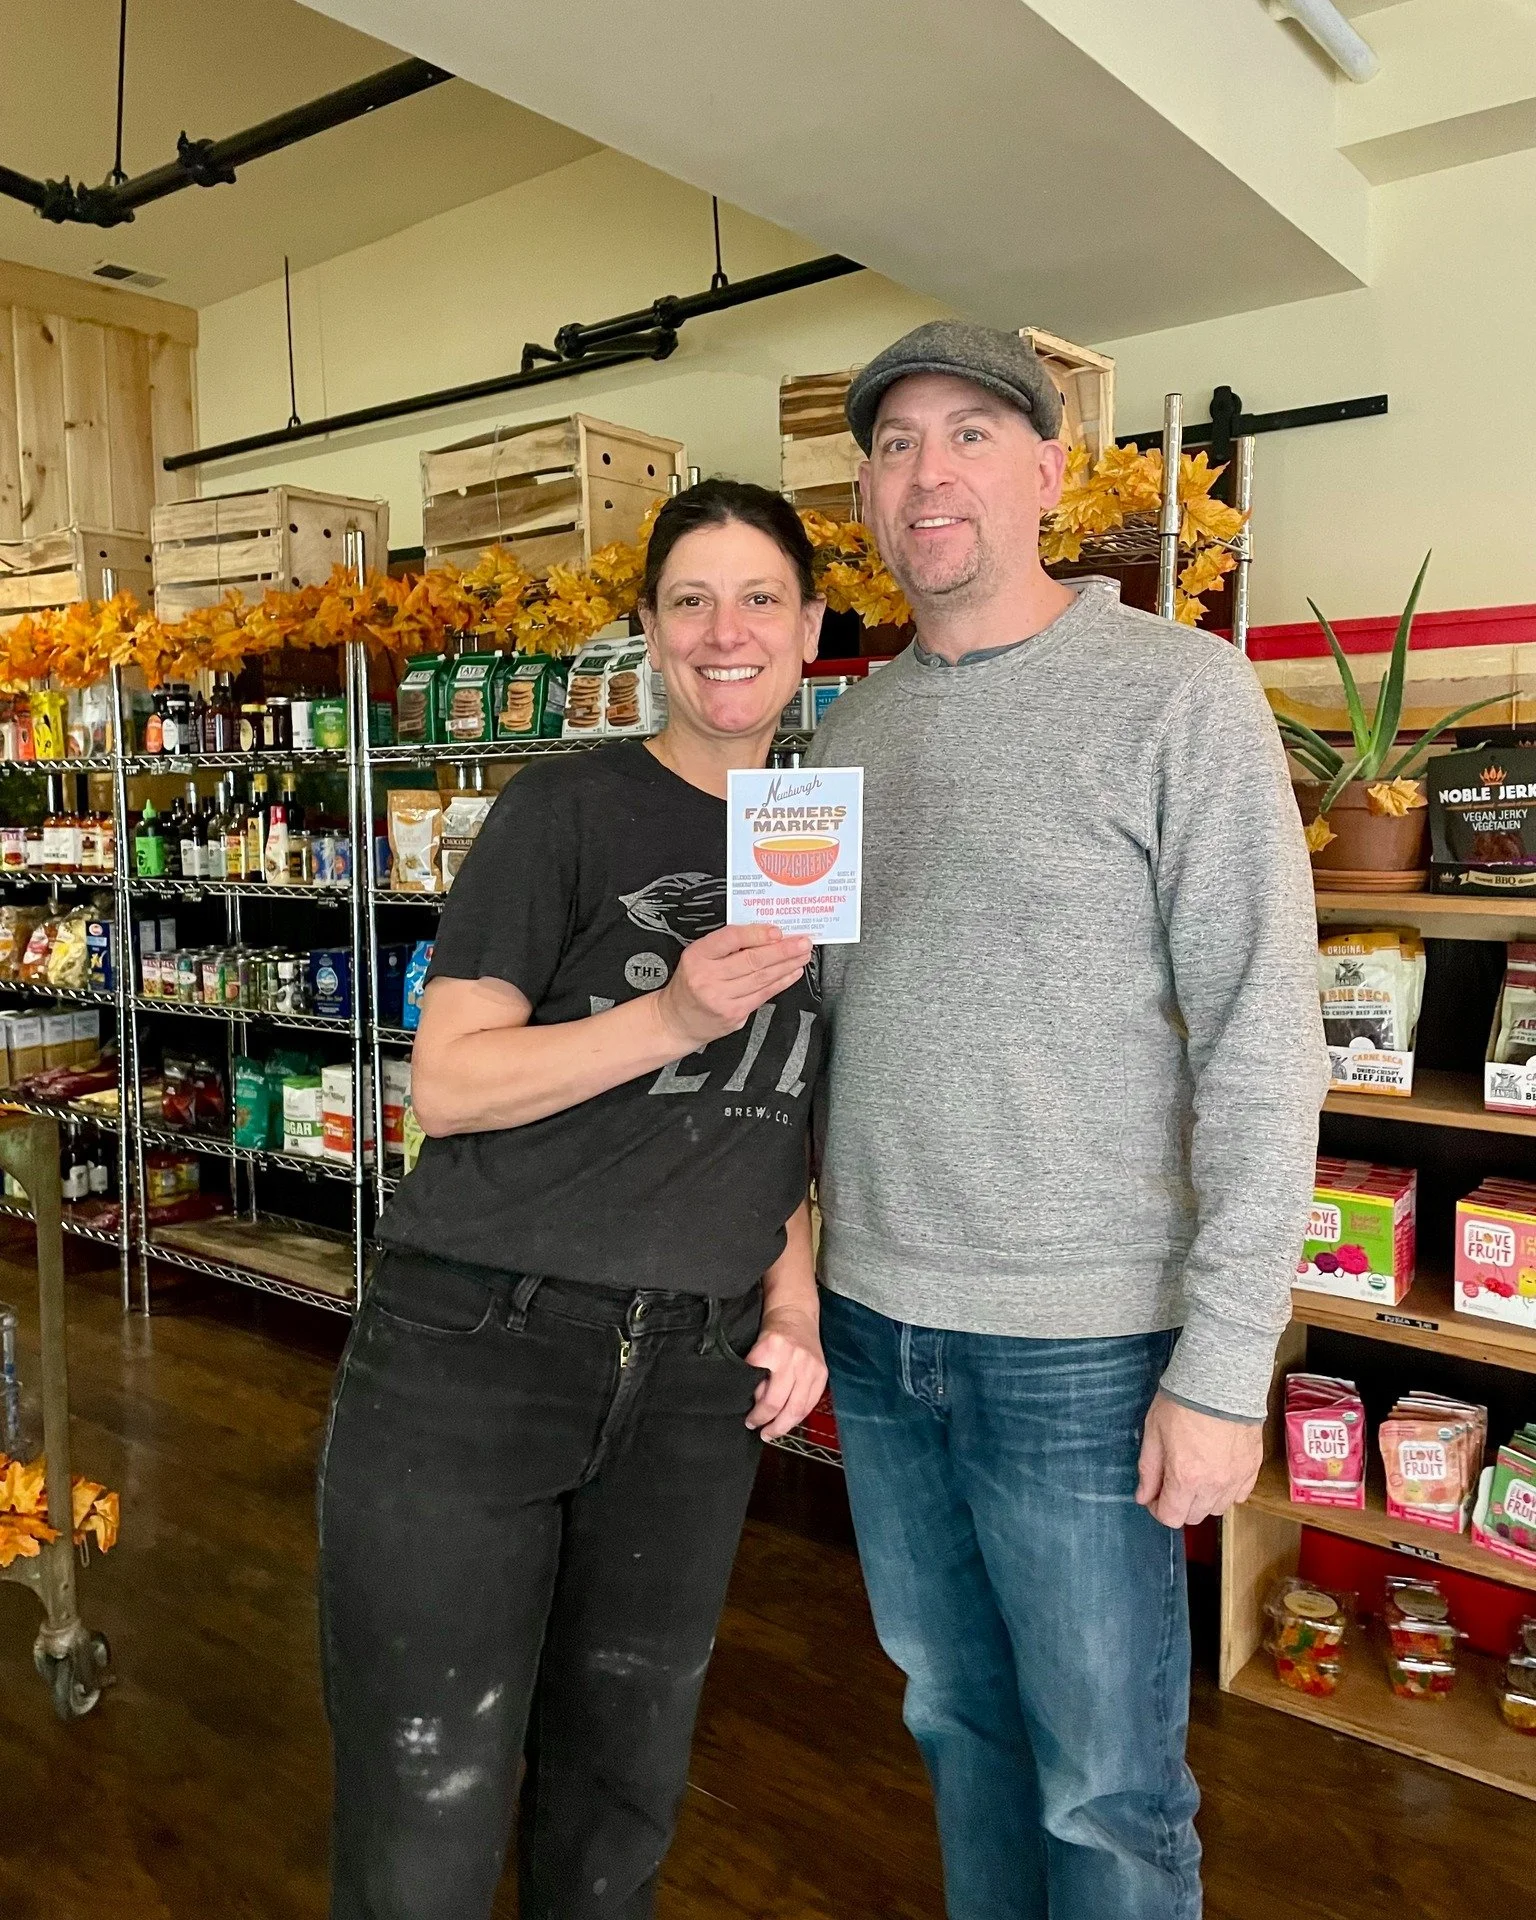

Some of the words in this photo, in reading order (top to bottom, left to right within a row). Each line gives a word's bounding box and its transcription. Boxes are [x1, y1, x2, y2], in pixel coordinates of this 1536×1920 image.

[762, 774, 823, 808] Newburgh
[1438, 787, 1491, 804] NOBLE
[745, 805, 847, 819] FARMERS
[1463, 810, 1496, 822] VEGAN
[1498, 808, 1528, 820] JERKY
[753, 819, 844, 832] MARKET
[760, 850, 834, 878] SOUP4GREENS
[1494, 876, 1517, 886] BBQ
[743, 898, 774, 907] SUPPORT
[775, 897, 790, 905] OUR
[791, 895, 847, 905] GREENS4GREENS
[756, 908, 774, 916] FOOD
[775, 907, 801, 915] ACCESS
[802, 905, 835, 914] PROGRAM
[1327, 945, 1366, 955] ORIGINAL
[632, 966, 661, 978] THE
[1352, 1073, 1374, 1081] BEEF
[1375, 1075, 1404, 1084] JERKY
[1304, 1221, 1338, 1239] RUIT
[1476, 1230, 1512, 1249] LOVE
[1468, 1242, 1511, 1262] FRUIT
[1313, 1429, 1345, 1441] LOVE
[1309, 1440, 1346, 1454] FRUIT
[1409, 1449, 1443, 1462] LOVE
[1405, 1462, 1443, 1475] FRUIT
